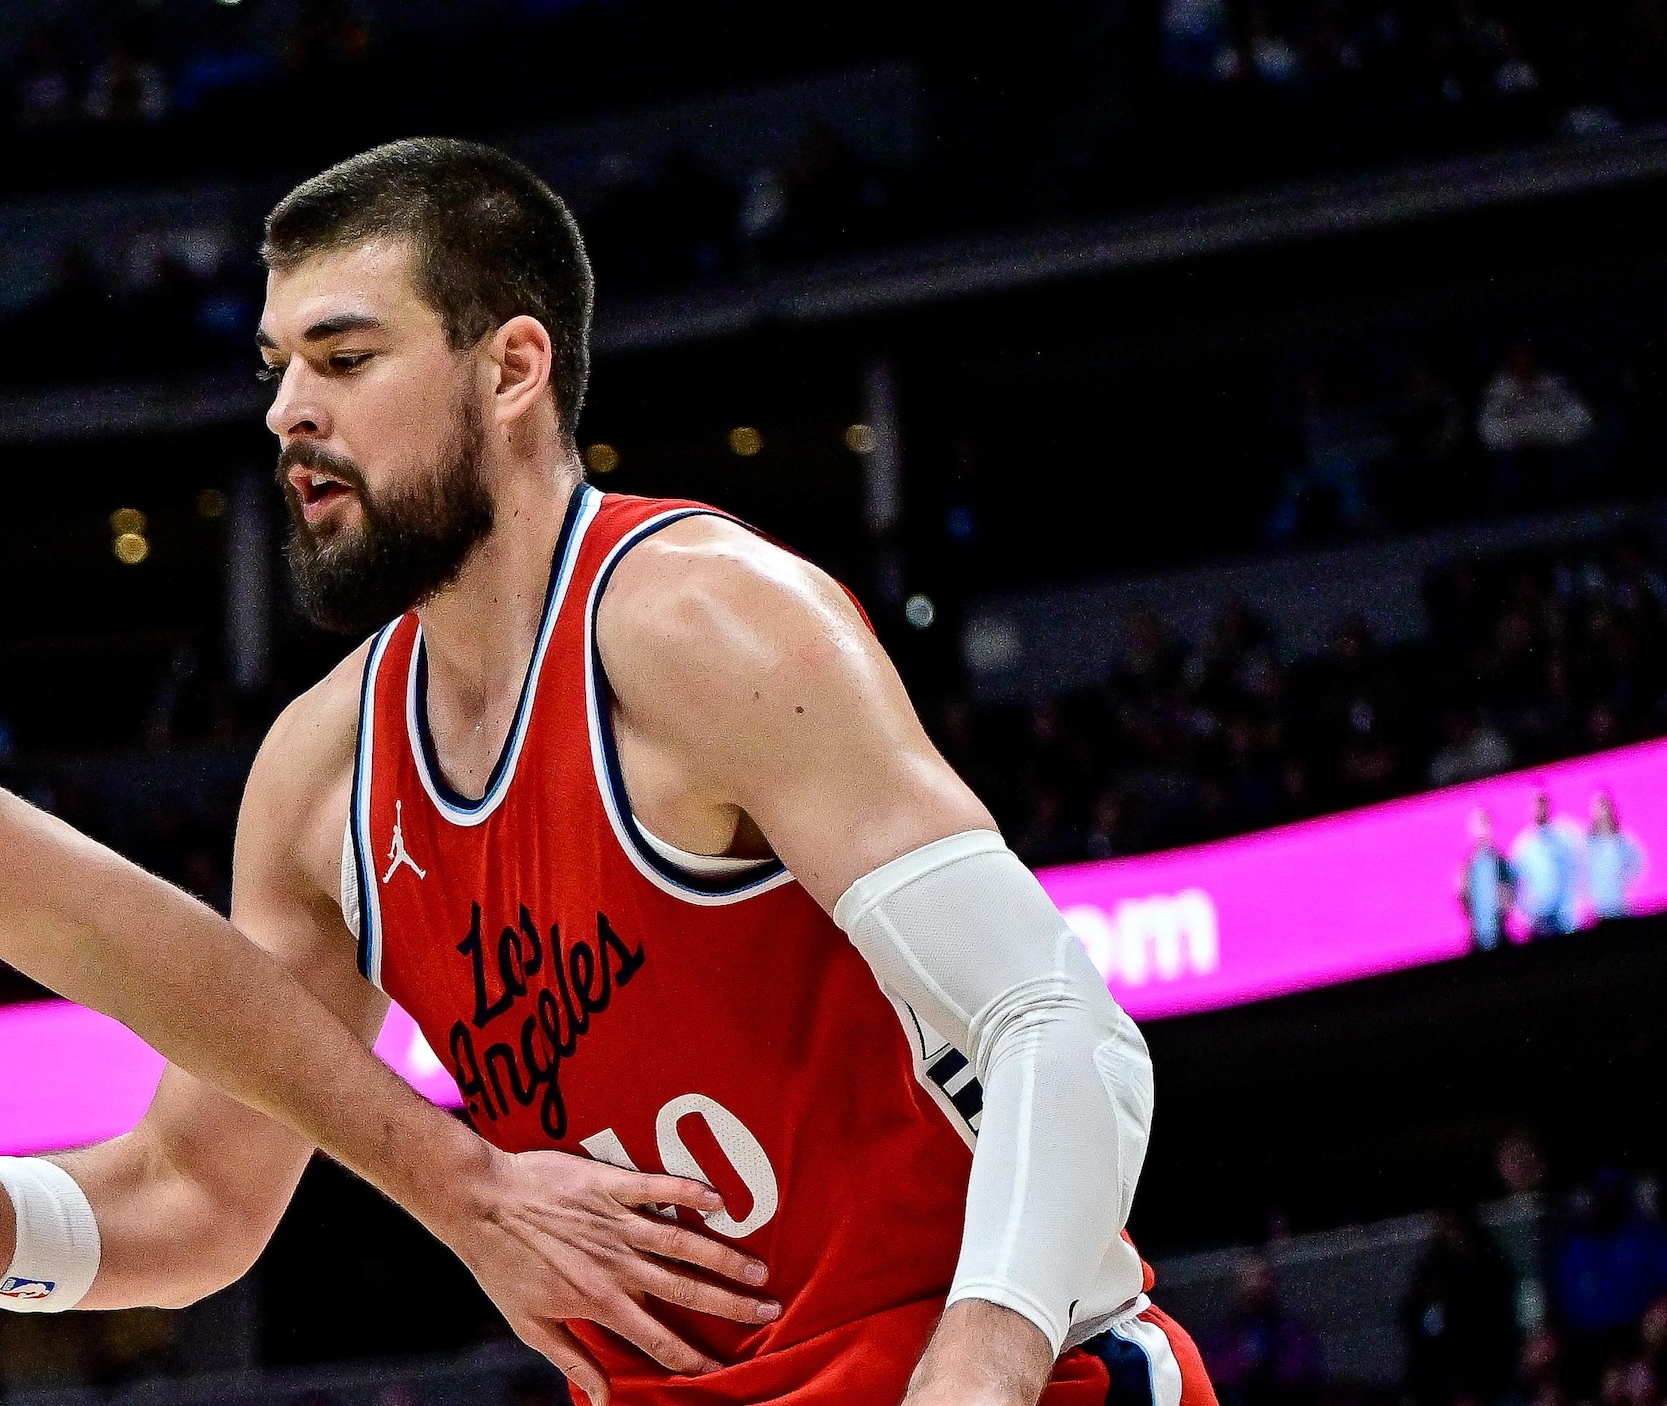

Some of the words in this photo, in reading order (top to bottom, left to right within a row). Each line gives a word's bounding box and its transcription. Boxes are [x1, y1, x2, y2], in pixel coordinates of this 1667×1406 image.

[449, 910, 647, 1141] Angeles
[455, 899, 544, 1031] Los
[578, 1092, 780, 1239] 0
